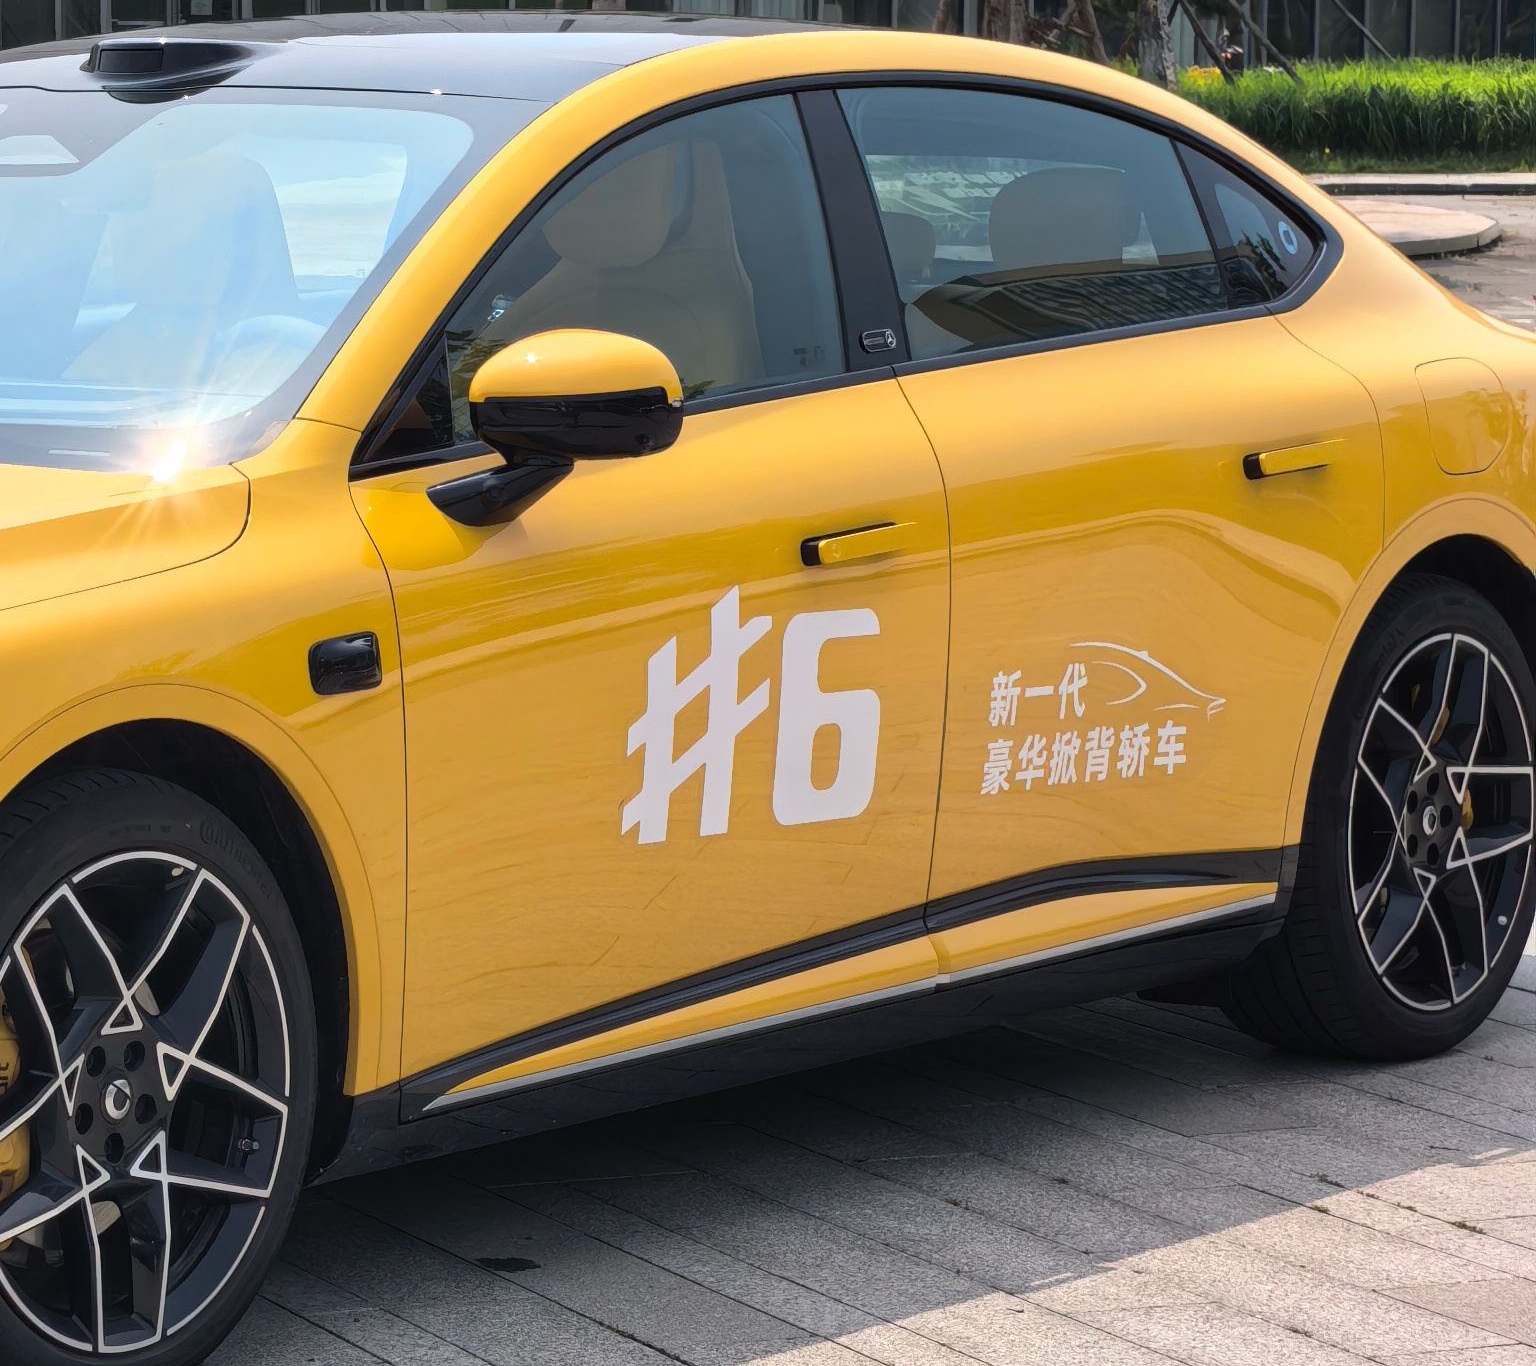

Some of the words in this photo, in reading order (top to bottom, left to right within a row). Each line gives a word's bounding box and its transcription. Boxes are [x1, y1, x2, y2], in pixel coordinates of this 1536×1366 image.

[621, 585, 882, 845] #6
[988, 662, 1088, 727] 新一代
[980, 719, 1187, 795] 豪华掀背轿车
